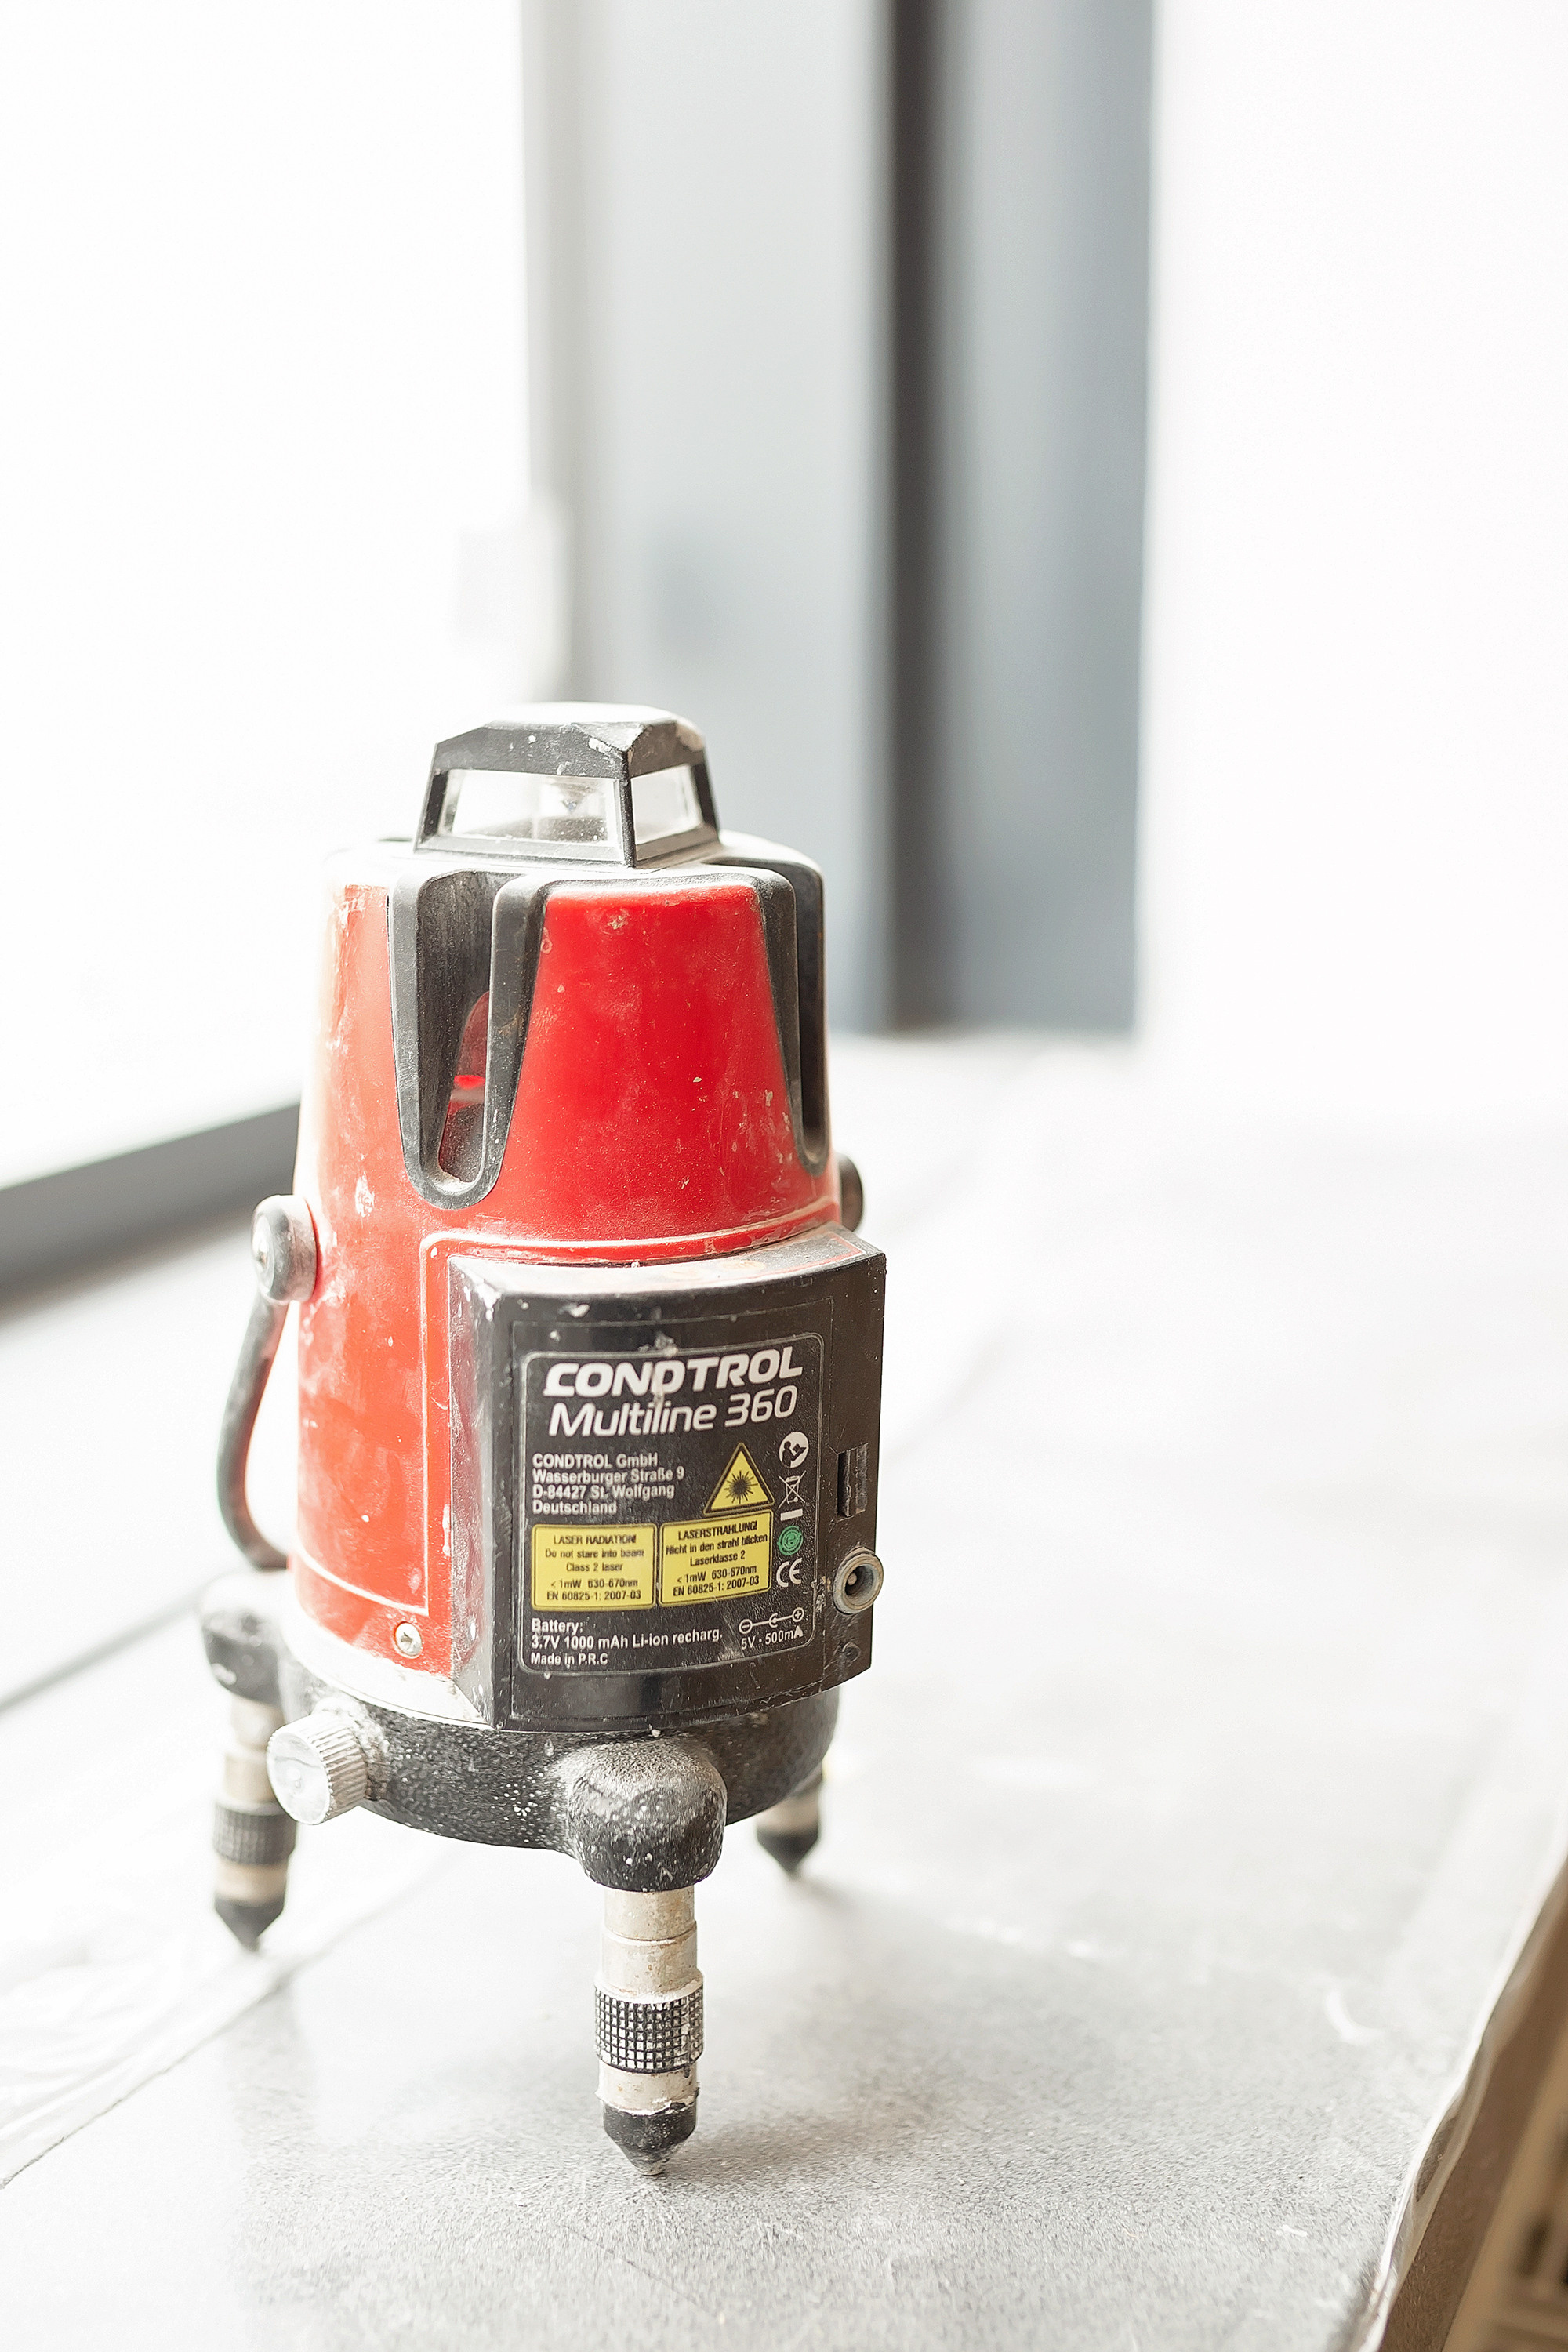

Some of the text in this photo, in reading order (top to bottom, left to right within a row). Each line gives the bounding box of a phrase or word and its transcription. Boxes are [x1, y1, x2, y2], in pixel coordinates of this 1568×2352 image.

[543, 1345, 804, 1398] CONDTROL
[550, 1385, 798, 1437] Multiline 360
[532, 1452, 658, 1469] CONDTROL GmbH
[532, 1465, 684, 1487] Wasserburger Straße 9
[532, 1484, 587, 1500] D-84427
[612, 1483, 675, 1501] Wolfgang
[532, 1500, 617, 1515] Deutschland
[554, 1535, 583, 1544] LASER
[666, 1533, 768, 1555] Nicht in den strahl blicken
[545, 1548, 557, 1558] Do
[560, 1548, 573, 1558] not
[576, 1549, 598, 1559] stare
[601, 1548, 618, 1558] into
[690, 1549, 746, 1567] Laserklasse 2
[566, 1563, 623, 1572] Class 2 laser
[776, 1557, 803, 1588] CE
[673, 1585, 684, 1596] EN
[726, 1575, 760, 1591] 2007-03
[547, 1591, 558, 1600] EN
[604, 1590, 641, 1600] 2007-03
[532, 1617, 583, 1635] Battery:
[532, 1628, 723, 1650] 3.7V 1000 mAh Li-ion recharg.
[741, 1625, 804, 1650] 5V 500mA
[530, 1652, 608, 1666] Made in P.R.C
